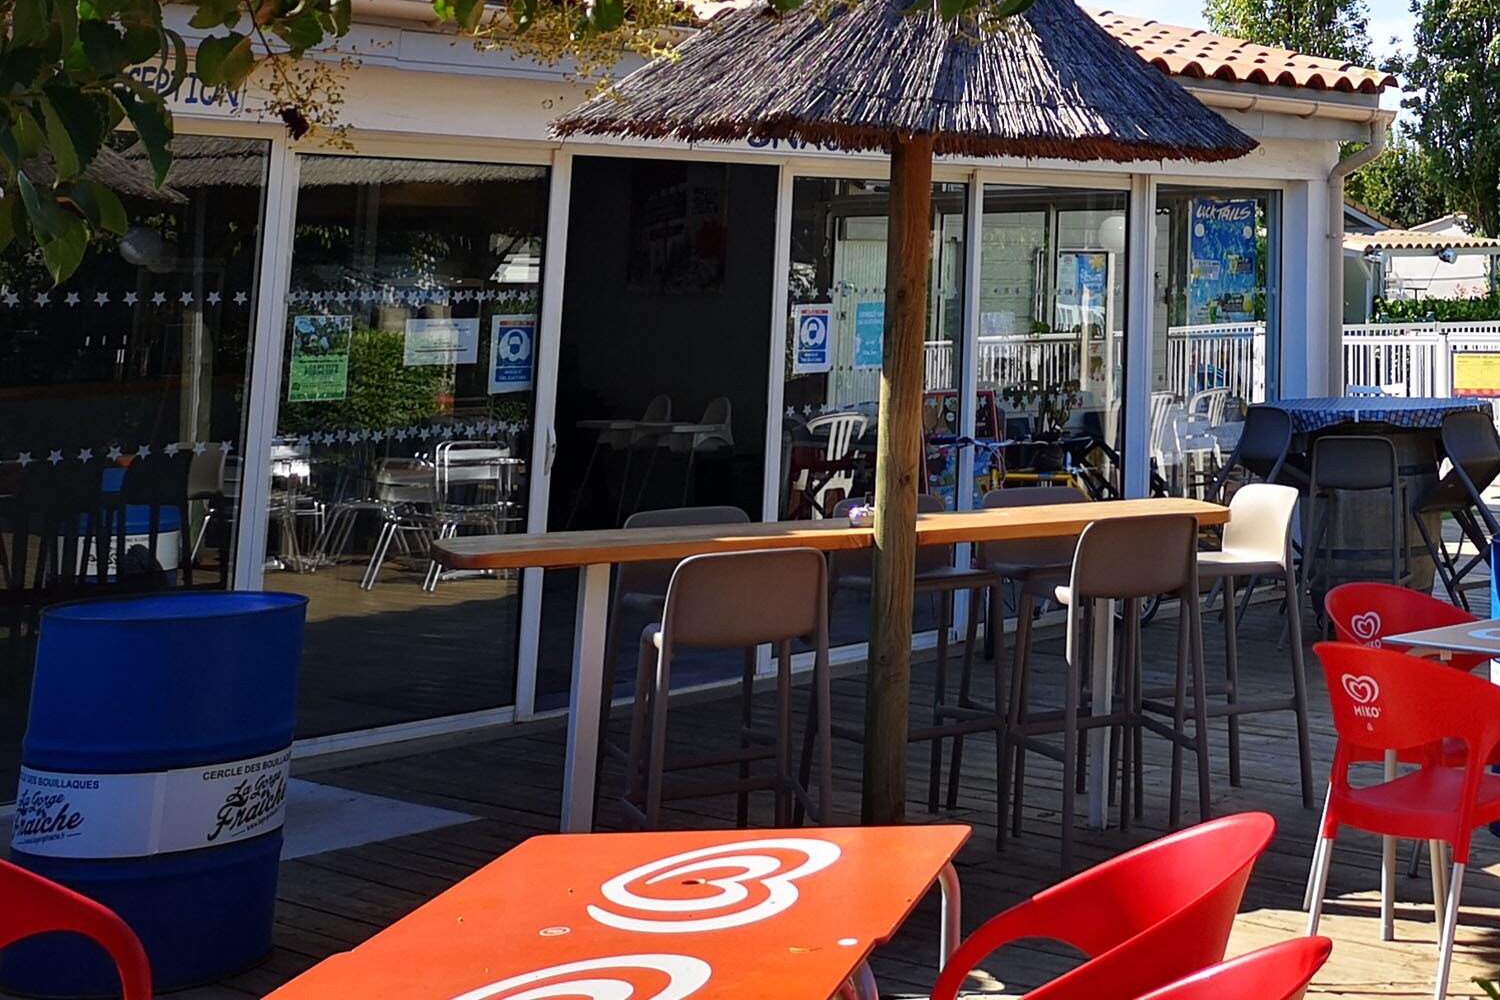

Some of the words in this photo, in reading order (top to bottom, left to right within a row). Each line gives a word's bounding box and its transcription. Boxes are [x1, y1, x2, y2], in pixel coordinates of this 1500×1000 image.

[1353, 705, 1380, 718] MIKO
[202, 767, 243, 781] CERCLE
[244, 762, 261, 774] DES
[38, 777, 100, 790] BOUILLAQUES
